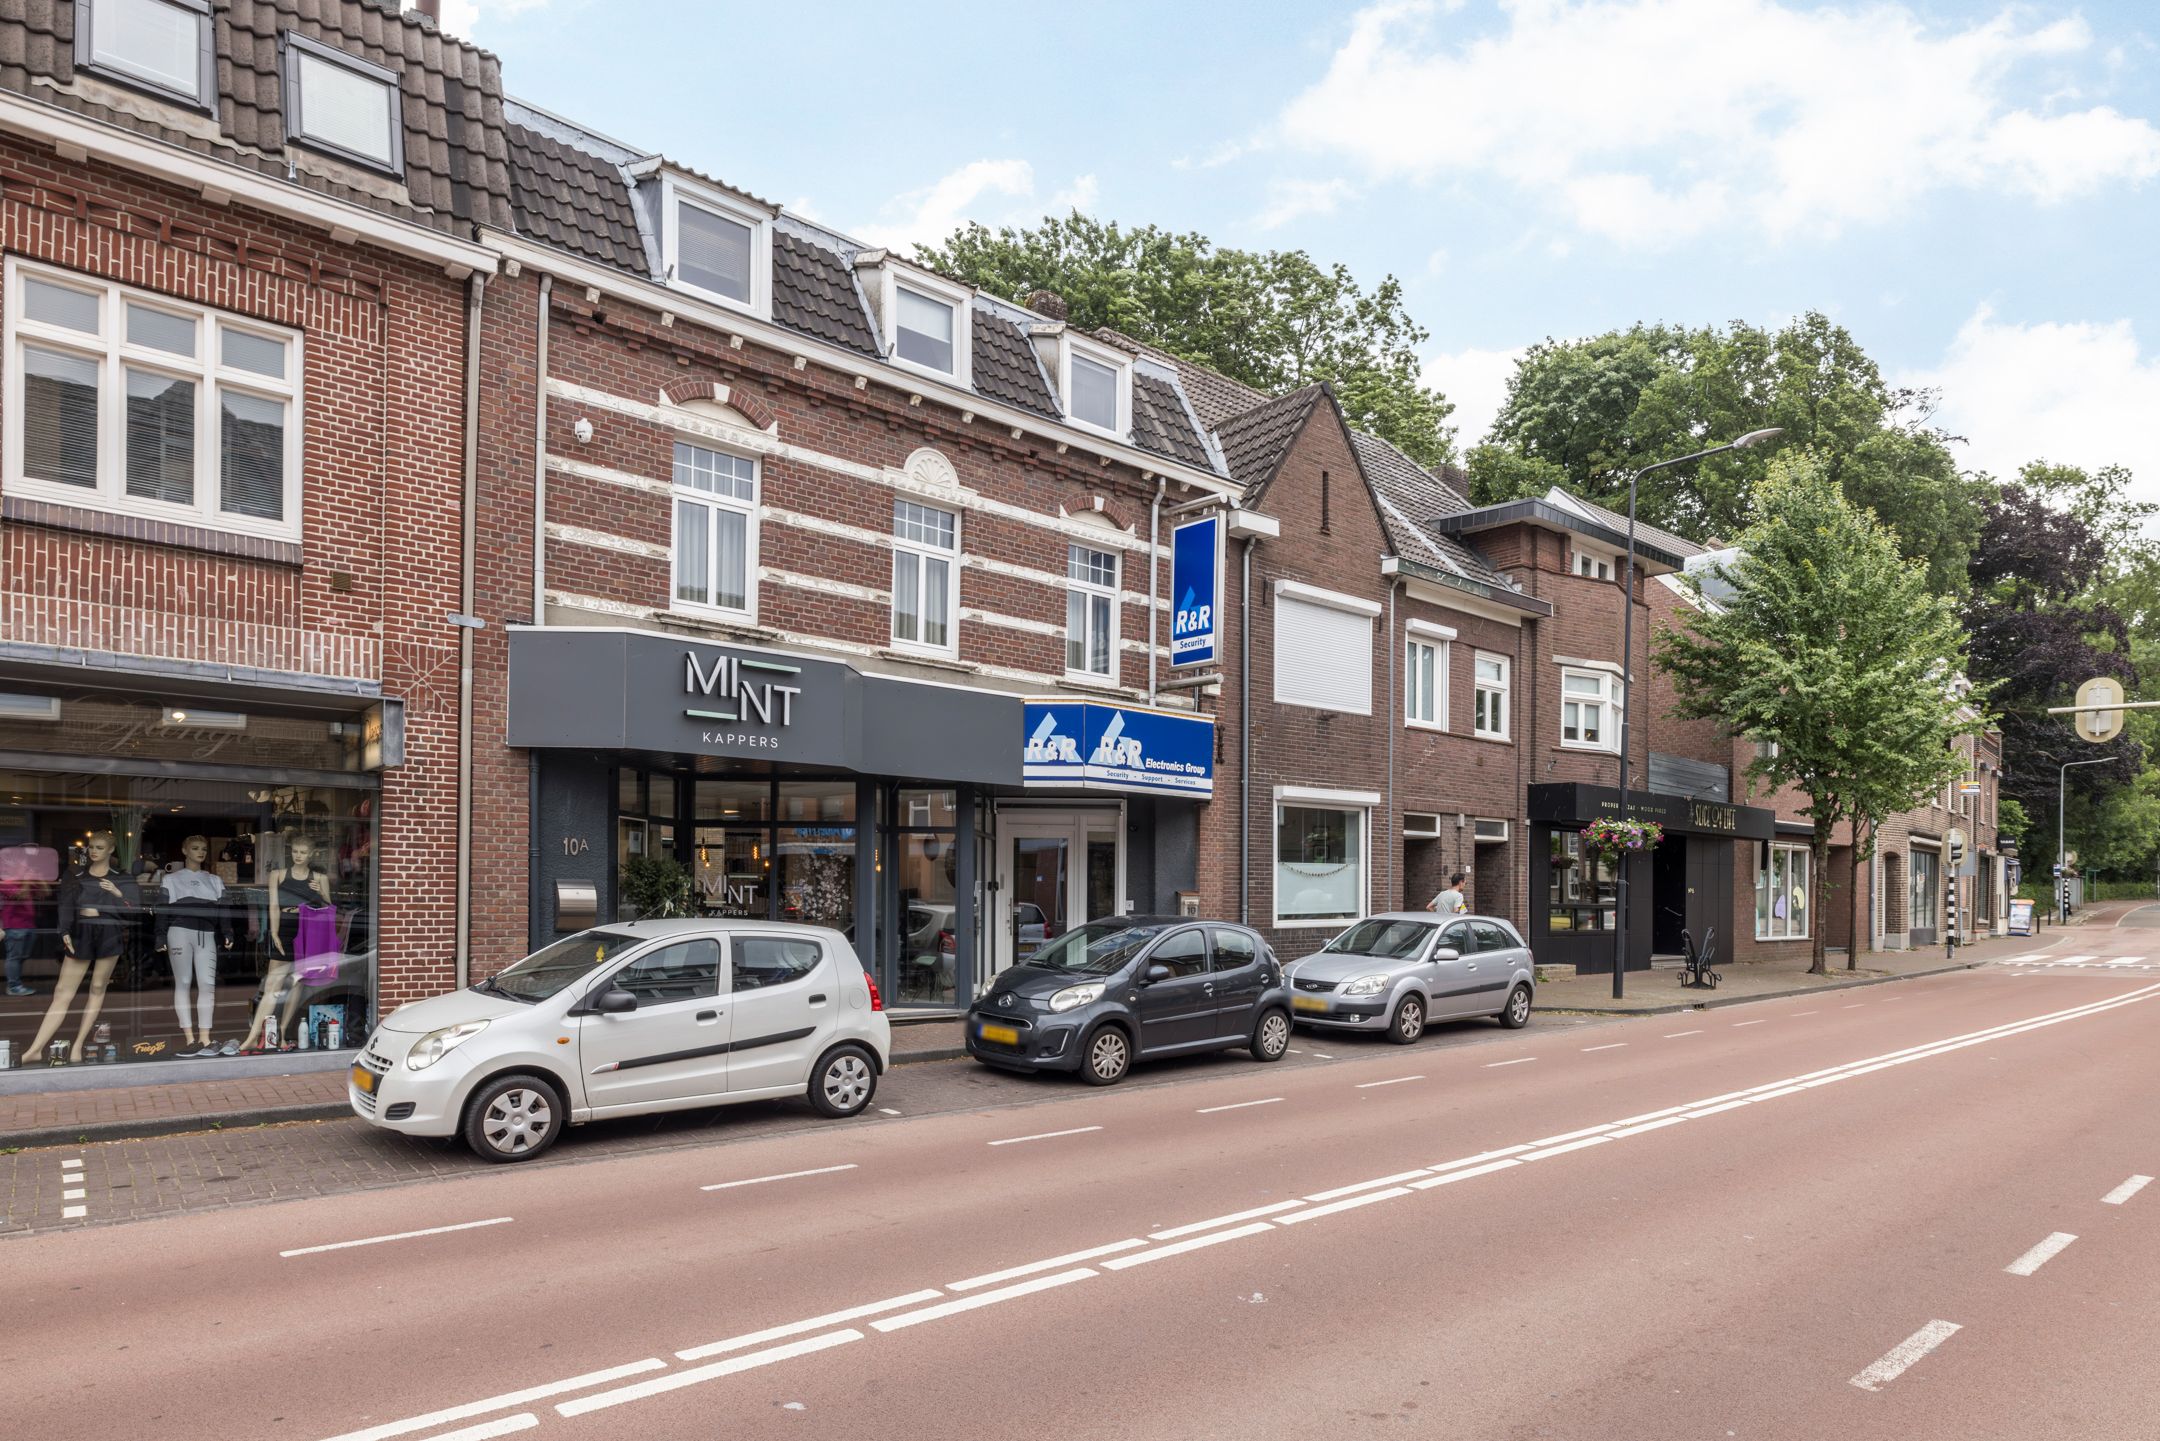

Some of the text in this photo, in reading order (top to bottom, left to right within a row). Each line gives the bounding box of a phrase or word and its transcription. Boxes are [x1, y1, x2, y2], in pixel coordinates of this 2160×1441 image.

[1175, 605, 1210, 634] R&R
[1180, 637, 1206, 649] Security
[685, 651, 801, 726] MINT
[702, 732, 779, 748] KAPPERS
[1027, 737, 1076, 761] R&R
[1100, 735, 1142, 767] R&R
[1145, 757, 1205, 777] Electronics Group
[1106, 770, 1196, 786] Security Support Services
[563, 837, 589, 856] 10A
[709, 908, 749, 917] KAPPERS
[1187, 905, 1196, 915] 10
